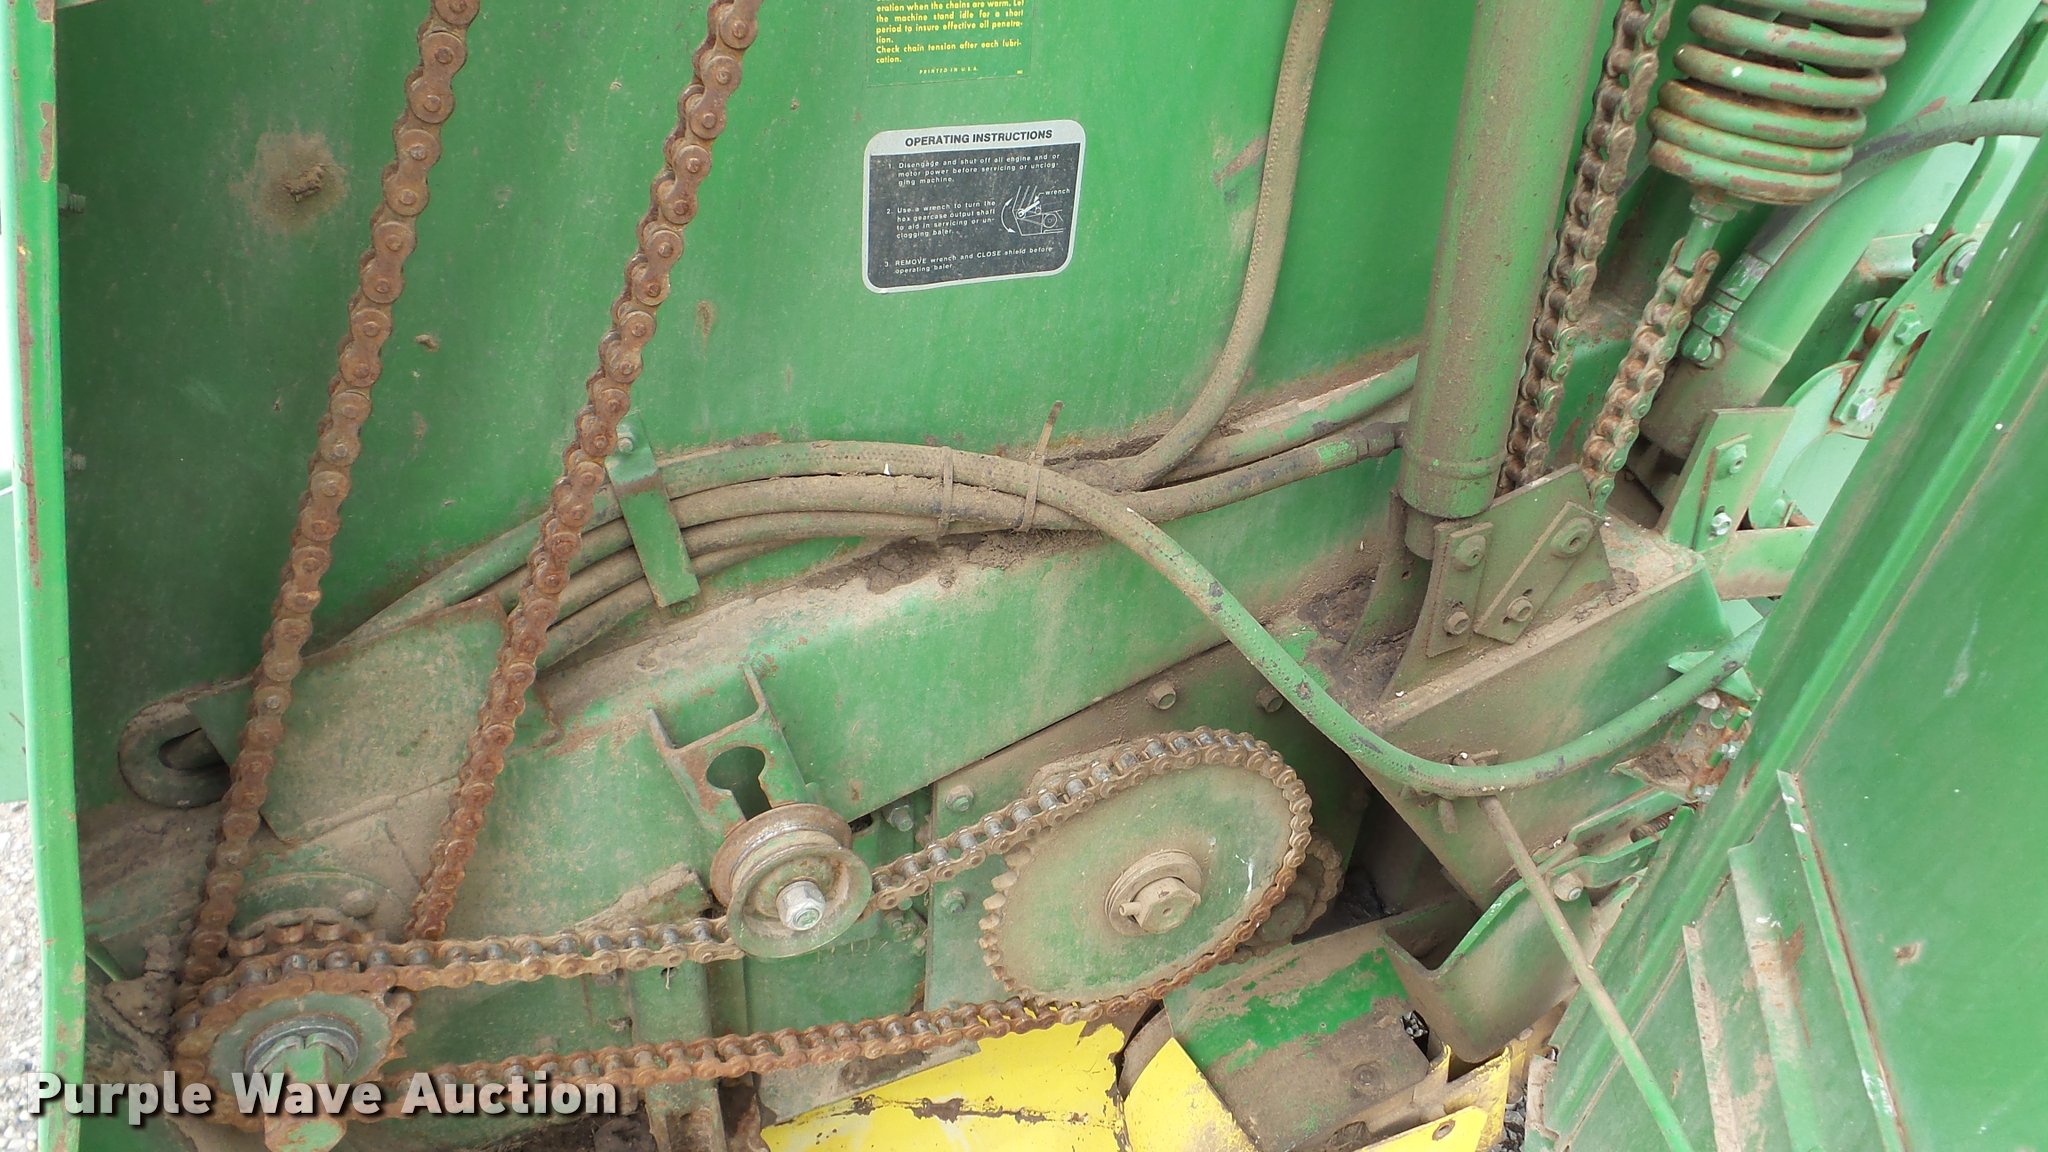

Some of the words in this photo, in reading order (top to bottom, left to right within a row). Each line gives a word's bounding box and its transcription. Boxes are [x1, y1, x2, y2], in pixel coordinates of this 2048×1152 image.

[877, 4, 904, 12] eration
[907, 2, 928, 11] when
[931, 1, 943, 10] the
[946, 0, 970, 9] chains
[972, 0, 984, 8] are
[876, 14, 888, 23] the
[894, 13, 927, 22] machine
[933, 11, 954, 20] stand
[960, 11, 974, 19] idle
[979, 10, 990, 18] for
[1006, 9, 1023, 17] short
[876, 25, 901, 34] period
[916, 23, 939, 31] insure
[943, 21, 976, 30] effective
[980, 21, 989, 29] oil
[992, 19, 1023, 29] penetra-
[876, 35, 894, 44] tion.
[876, 45, 900, 54] Check
[904, 44, 924, 52] chain
[928, 42, 956, 51] tension
[960, 40, 978, 49] after
[981, 40, 998, 48] each
[876, 56, 901, 64] cation.
[905, 132, 970, 147] OPERATING
[972, 129, 1052, 142] INSTRUCTIONS
[898, 160, 939, 169] Disengage
[960, 157, 977, 165] shut
[1006, 155, 1031, 164] engine
[898, 170, 921, 178] motor
[924, 169, 949, 177] power
[952, 166, 977, 174] before
[982, 163, 1016, 173] servicing
[898, 178, 916, 186] ging
[1045, 188, 1071, 196] wrench
[897, 206, 911, 214] Use
[923, 203, 950, 212] wrench
[913, 212, 948, 222] gearcase
[950, 211, 974, 219] output
[933, 218, 968, 228] servicing
[896, 231, 929, 240] clogging
[895, 258, 927, 266] REMOVE
[930, 255, 957, 263] wrench
[976, 250, 1001, 258] CLOSE
[1004, 248, 1026, 256] shield
[895, 265, 930, 274] operating
